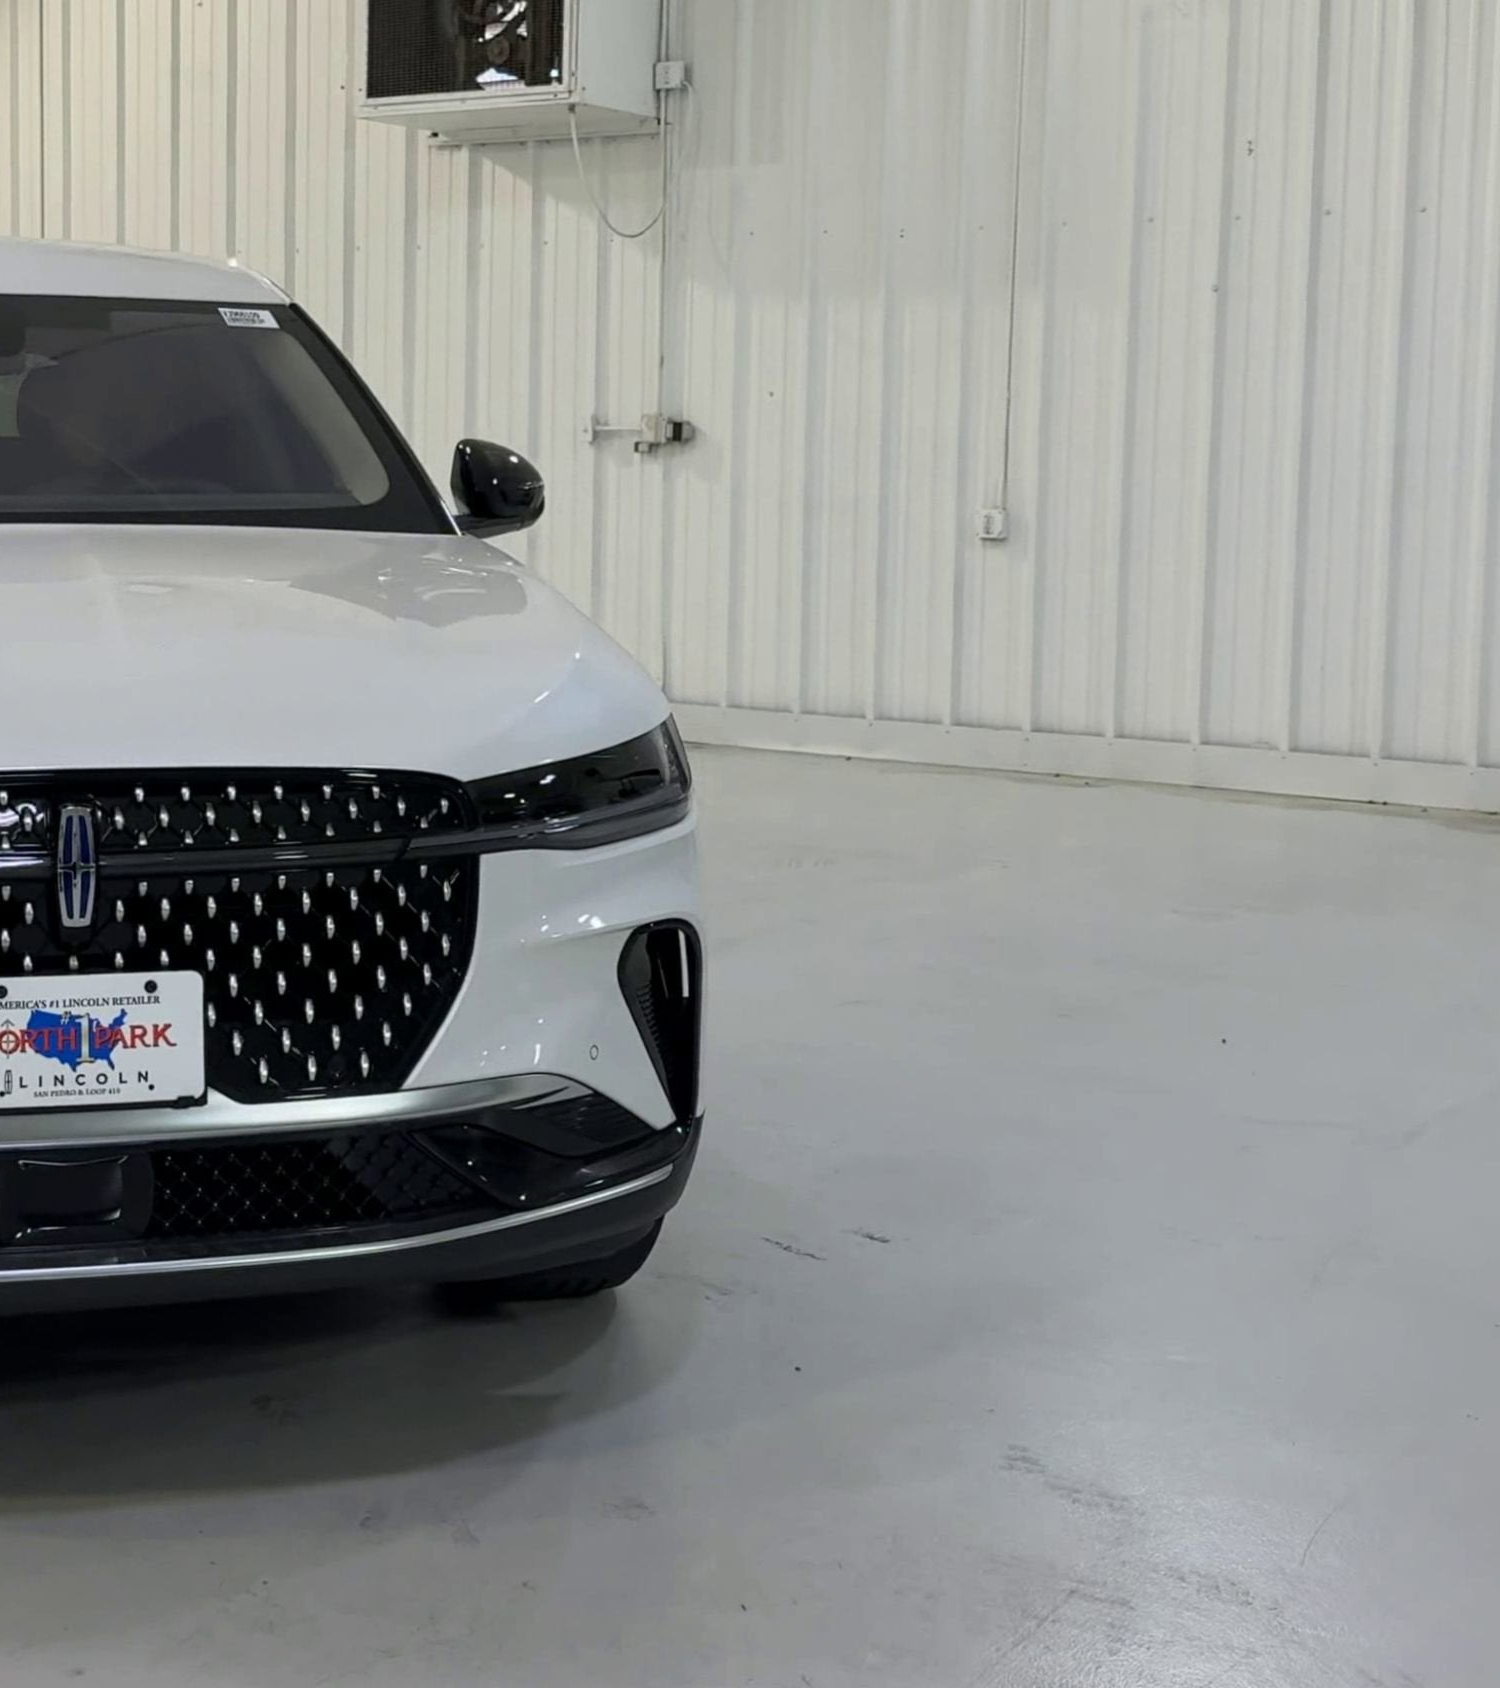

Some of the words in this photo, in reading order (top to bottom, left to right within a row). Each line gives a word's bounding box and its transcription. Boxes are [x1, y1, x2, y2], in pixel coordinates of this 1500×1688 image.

[49, 997, 60, 1008] #1
[62, 997, 110, 1008] LINCOLN
[112, 995, 162, 1006] RETAILER
[94, 1023, 178, 1050] PARK
[18, 1070, 149, 1088] LINCOLN
[33, 1090, 49, 1098] SAN
[50, 1089, 77, 1097] PEDRO
[85, 1088, 106, 1096] LOOP
